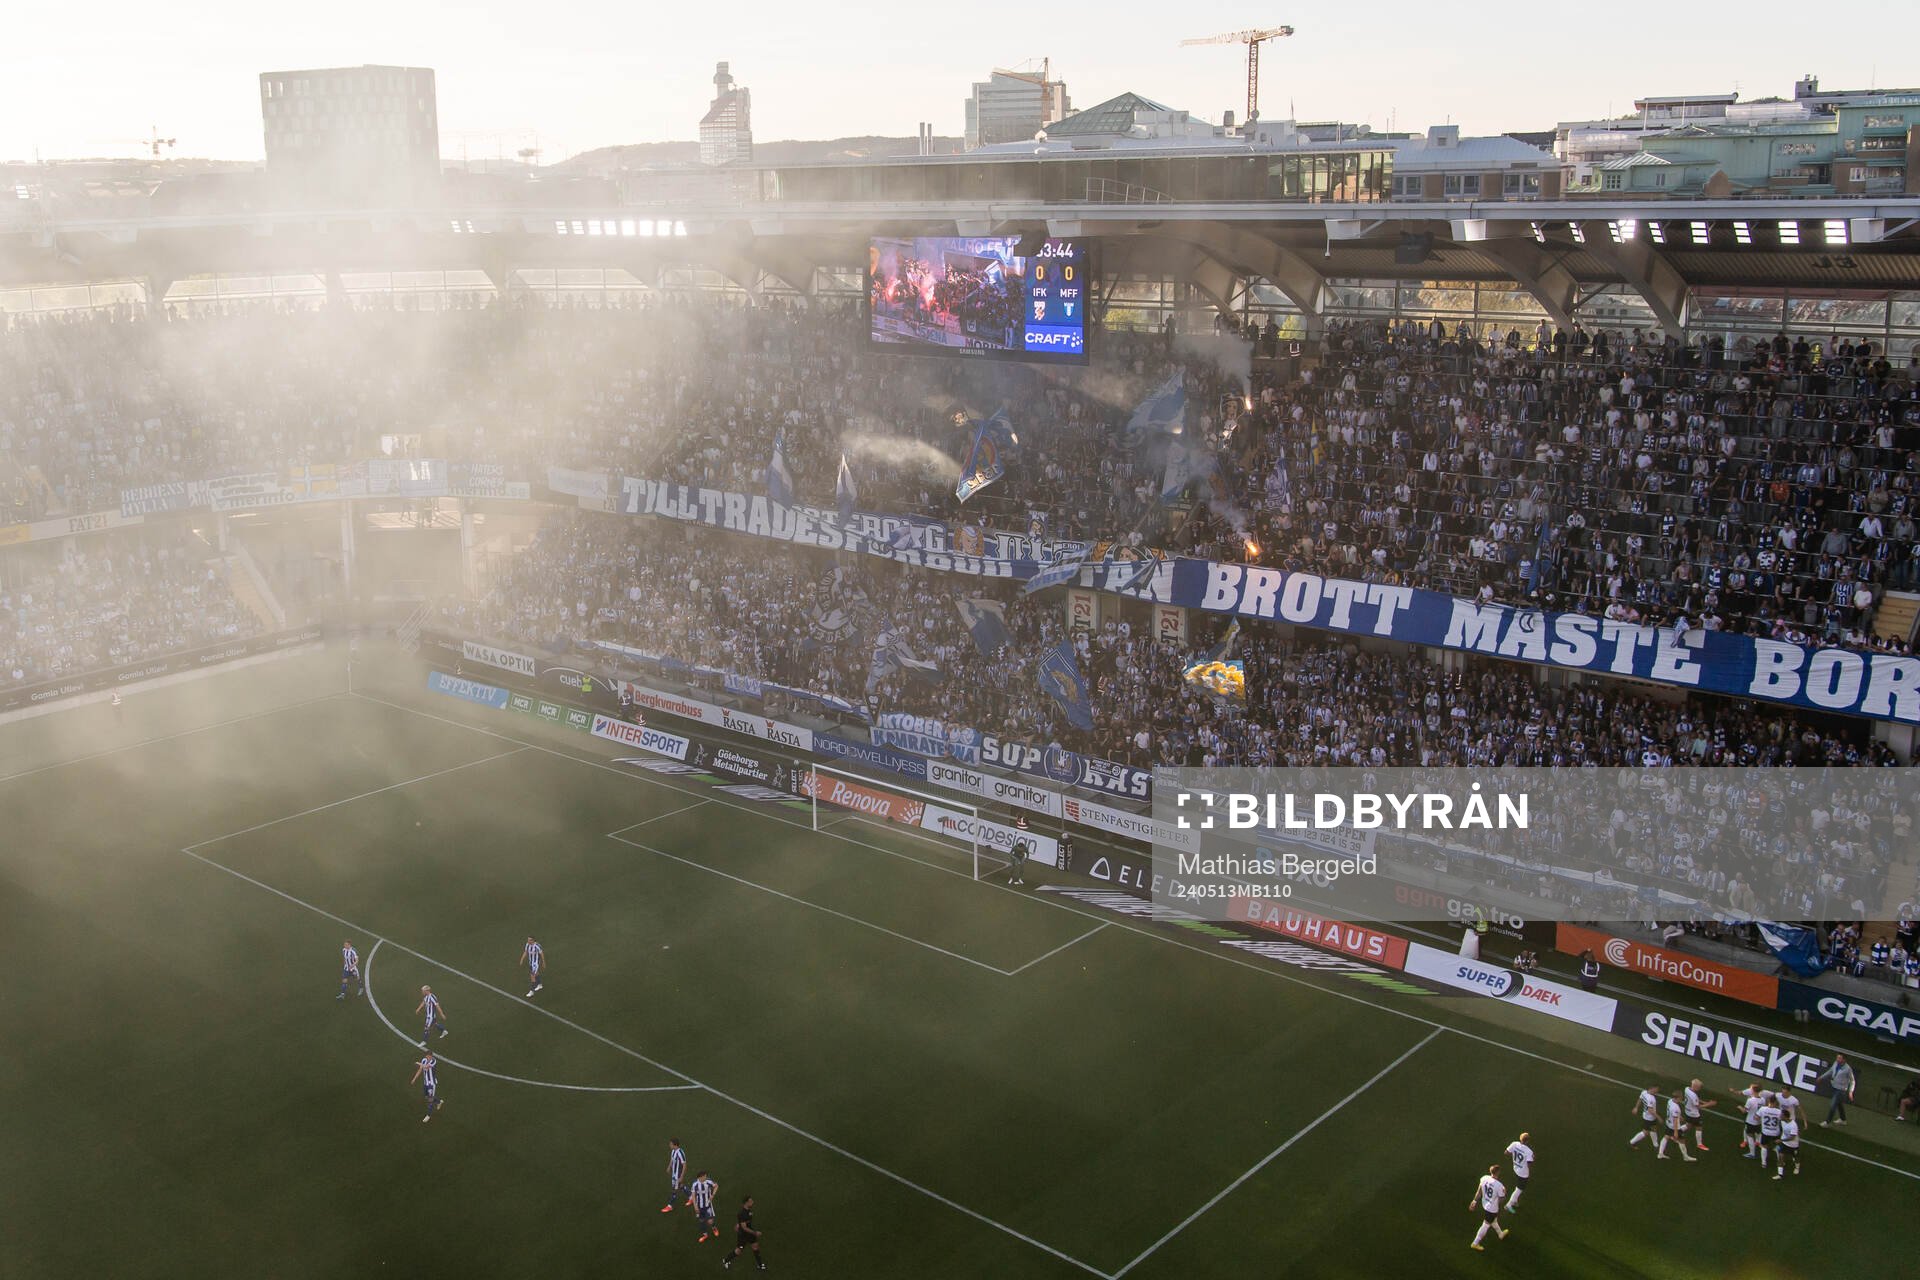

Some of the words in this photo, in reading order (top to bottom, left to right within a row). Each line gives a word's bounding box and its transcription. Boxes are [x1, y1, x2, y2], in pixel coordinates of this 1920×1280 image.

[1036, 265, 1044, 280] 0
[1065, 266, 1073, 281] 0
[1033, 287, 1047, 297] IFK
[1060, 288, 1078, 298] MFF
[1025, 332, 1070, 345] CRAFT
[68, 514, 108, 533] FAT21
[1201, 563, 1414, 637] BROTT
[464, 644, 497, 665] WASA
[500, 653, 534, 673] OPTIK
[118, 669, 145, 682] Gamla
[30, 687, 59, 702] Gamla
[60, 683, 84, 698] Ullevi
[439, 675, 496, 702] EFFEKTIV
[513, 696, 529, 709] MCR
[541, 704, 557, 717] MCR
[635, 690, 703, 718] Bergkvarabuss
[569, 711, 587, 725] MCR
[723, 716, 756, 735] RASTA
[880, 713, 943, 739] KTOBER
[606, 721, 683, 755] INTERSPORT
[767, 728, 801, 747] RASTA
[712, 757, 768, 782] Metallpartier
[717, 748, 759, 769] Göteborgs
[932, 765, 981, 787] granitor
[830, 781, 891, 816] Renova
[994, 782, 1047, 805] granitor
[1081, 808, 1190, 845] STENFASTIGHETER
[1304, 828, 1317, 840] 123
[1339, 838, 1347, 848] 15
[1350, 841, 1361, 852] 39
[1247, 899, 1385, 957] BAUHAUS
[1456, 966, 1506, 991] SUPER
[1636, 947, 1725, 989] InfraCom
[1817, 996, 1920, 1038] CRAF
[1641, 1011, 1820, 1093] SERNEKE
[1763, 1115, 1779, 1128] 23
[1513, 1150, 1524, 1164] 19
[1484, 1184, 1494, 1199] 18
